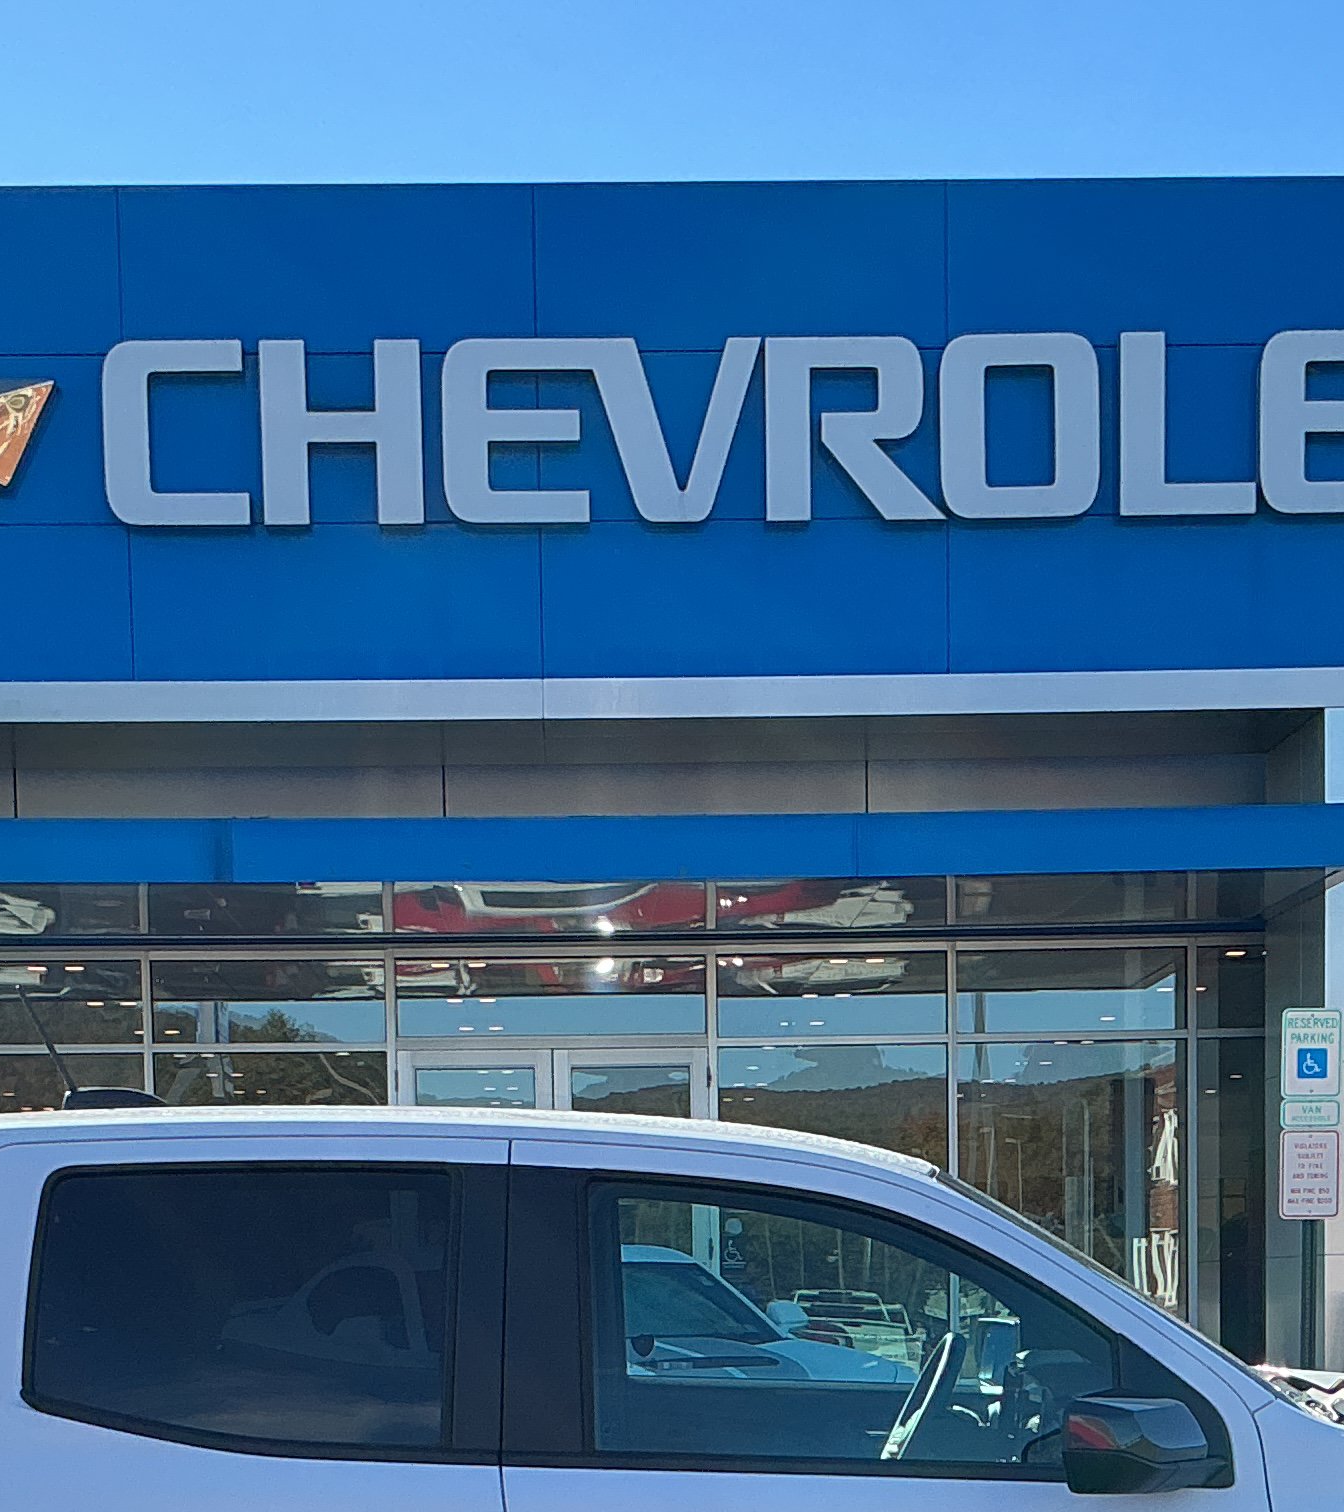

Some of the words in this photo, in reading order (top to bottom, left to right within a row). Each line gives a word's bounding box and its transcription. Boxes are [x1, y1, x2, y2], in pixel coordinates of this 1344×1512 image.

[1287, 1017, 1338, 1029] RESERVED
[1290, 1032, 1335, 1045] PARKING
[1301, 1105, 1322, 1115] VAN
